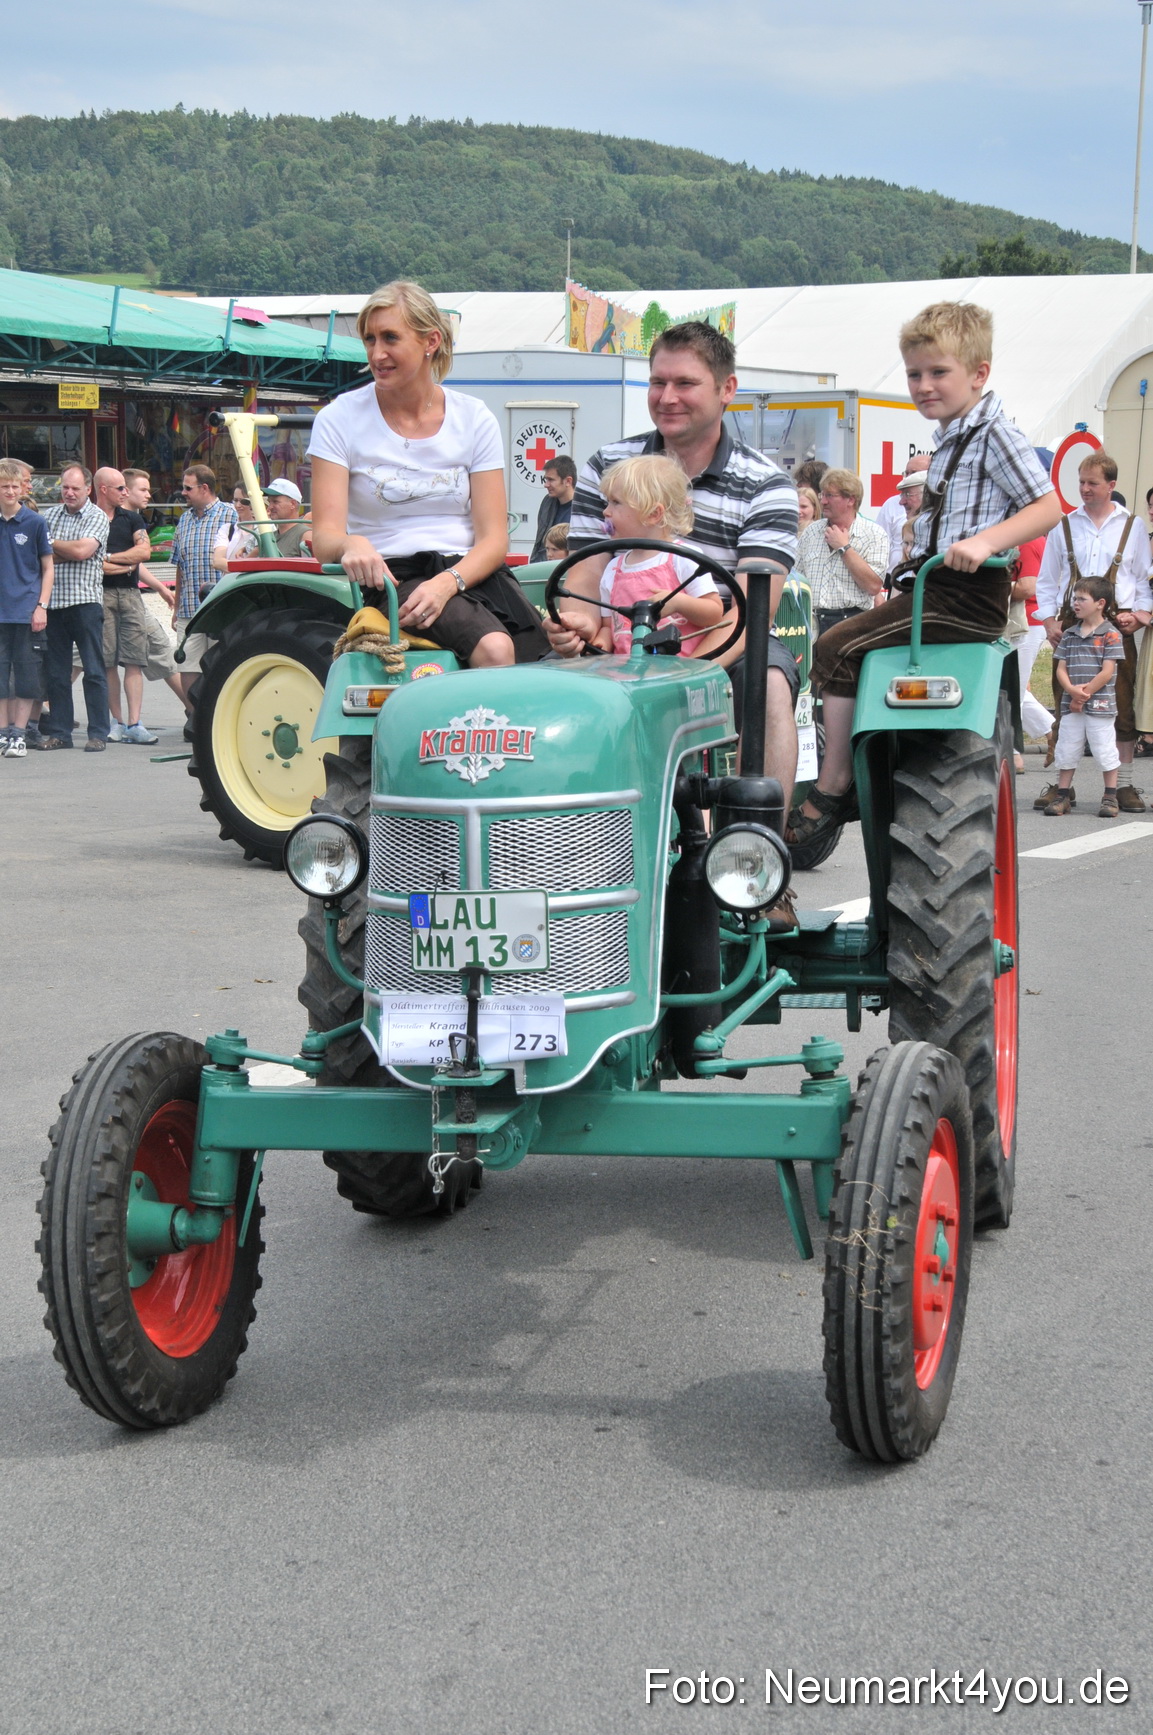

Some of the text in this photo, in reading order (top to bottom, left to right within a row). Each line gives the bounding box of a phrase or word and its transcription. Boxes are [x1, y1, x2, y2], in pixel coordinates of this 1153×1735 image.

[516, 424, 566, 448] DEUTSCHES
[514, 454, 537, 483] ROTES
[419, 729, 534, 758] Kramer
[802, 742, 815, 751] 283
[417, 915, 425, 926] D
[430, 897, 497, 930] LAU
[416, 934, 509, 967] MM 13
[390, 1002, 550, 1013] Oldtimertreffen ühlhausen 2009
[514, 1033, 558, 1051] 273
